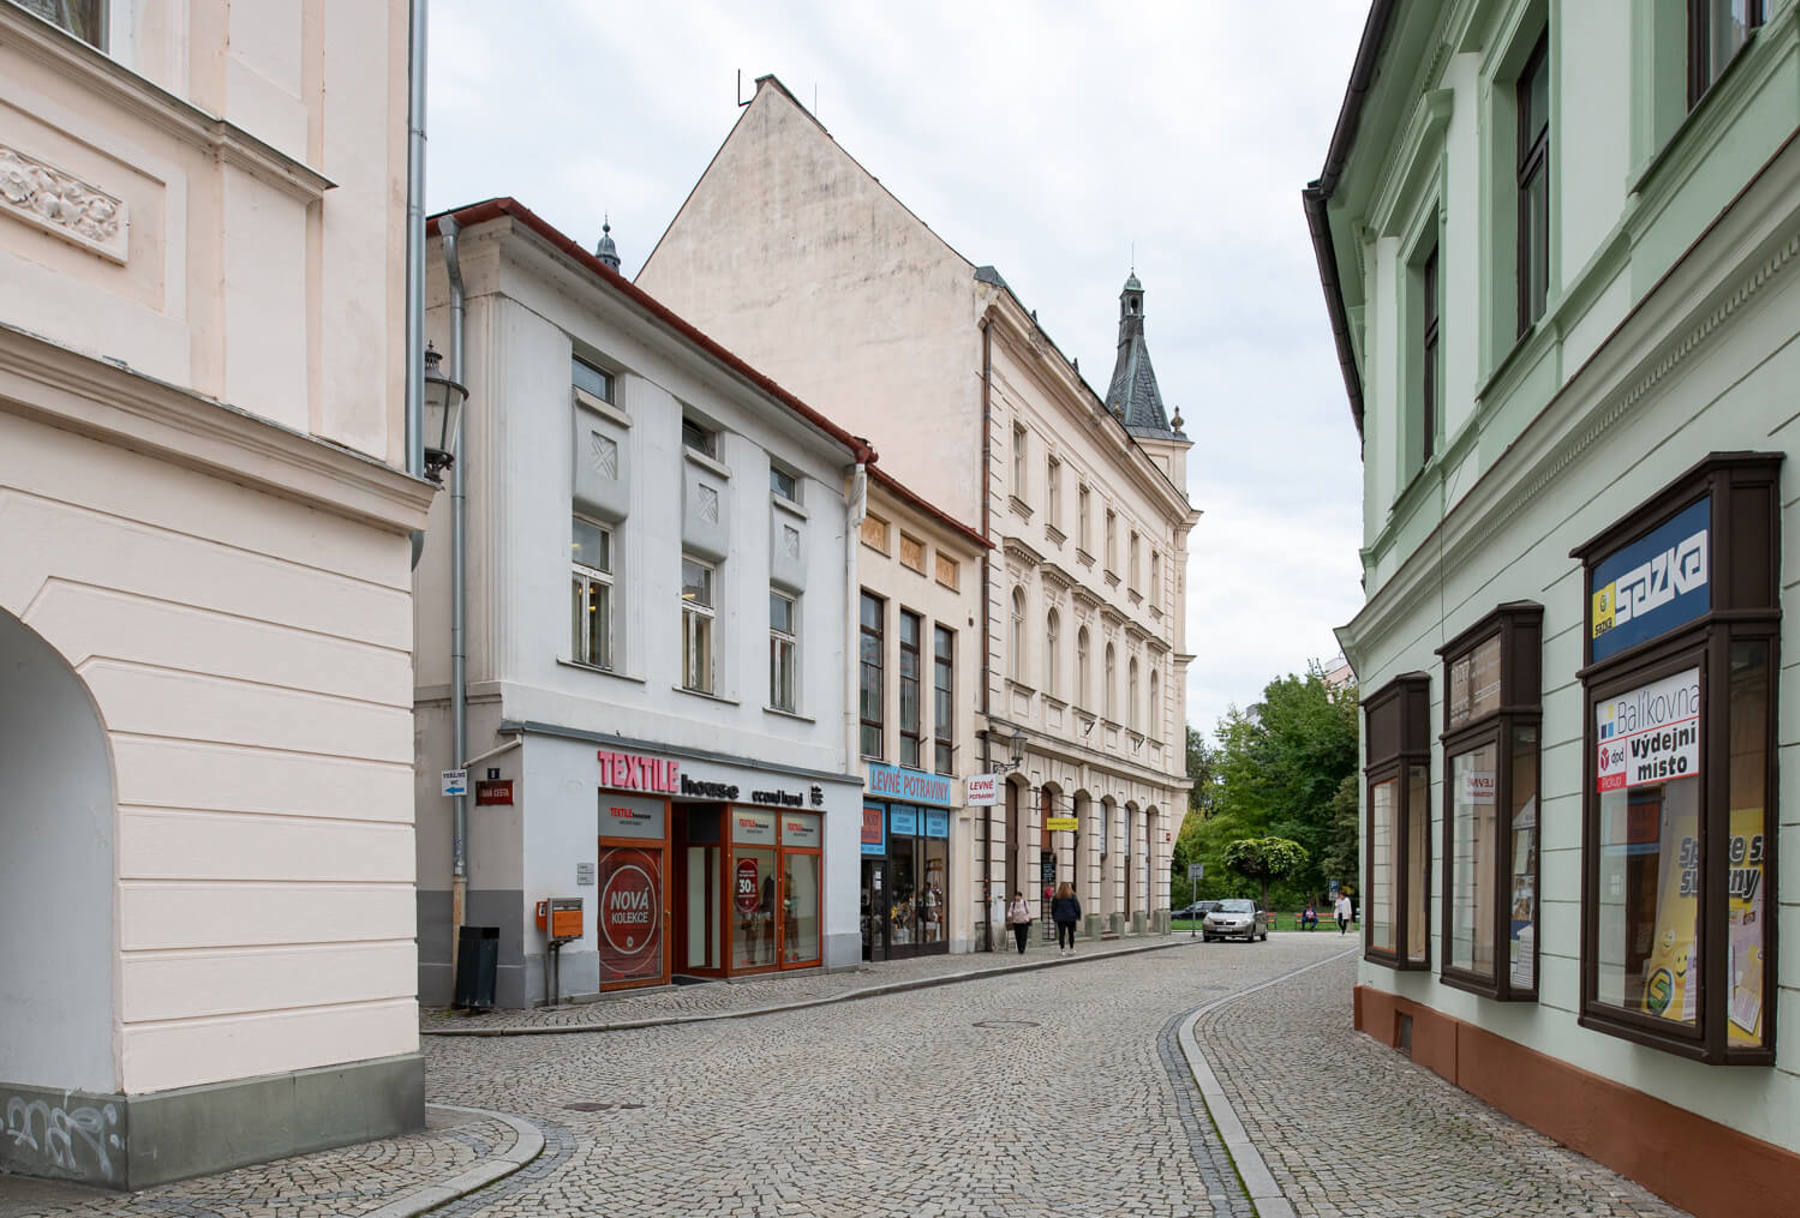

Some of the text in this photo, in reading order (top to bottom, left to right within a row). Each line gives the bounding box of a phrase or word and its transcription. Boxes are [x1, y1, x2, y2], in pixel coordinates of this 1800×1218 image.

[1617, 684, 1699, 735] Balíkovna
[1631, 721, 1696, 760] Výdejní
[1611, 747, 1624, 766] dpd
[1638, 753, 1687, 781] místo
[598, 751, 680, 792] TEXTILE
[681, 774, 739, 799] house
[872, 767, 948, 800] LEVNÉ POTRAVINY
[969, 778, 994, 790] LEVNÉ
[611, 886, 649, 910] NOVÁ
[612, 911, 648, 924] KOLEKCE
